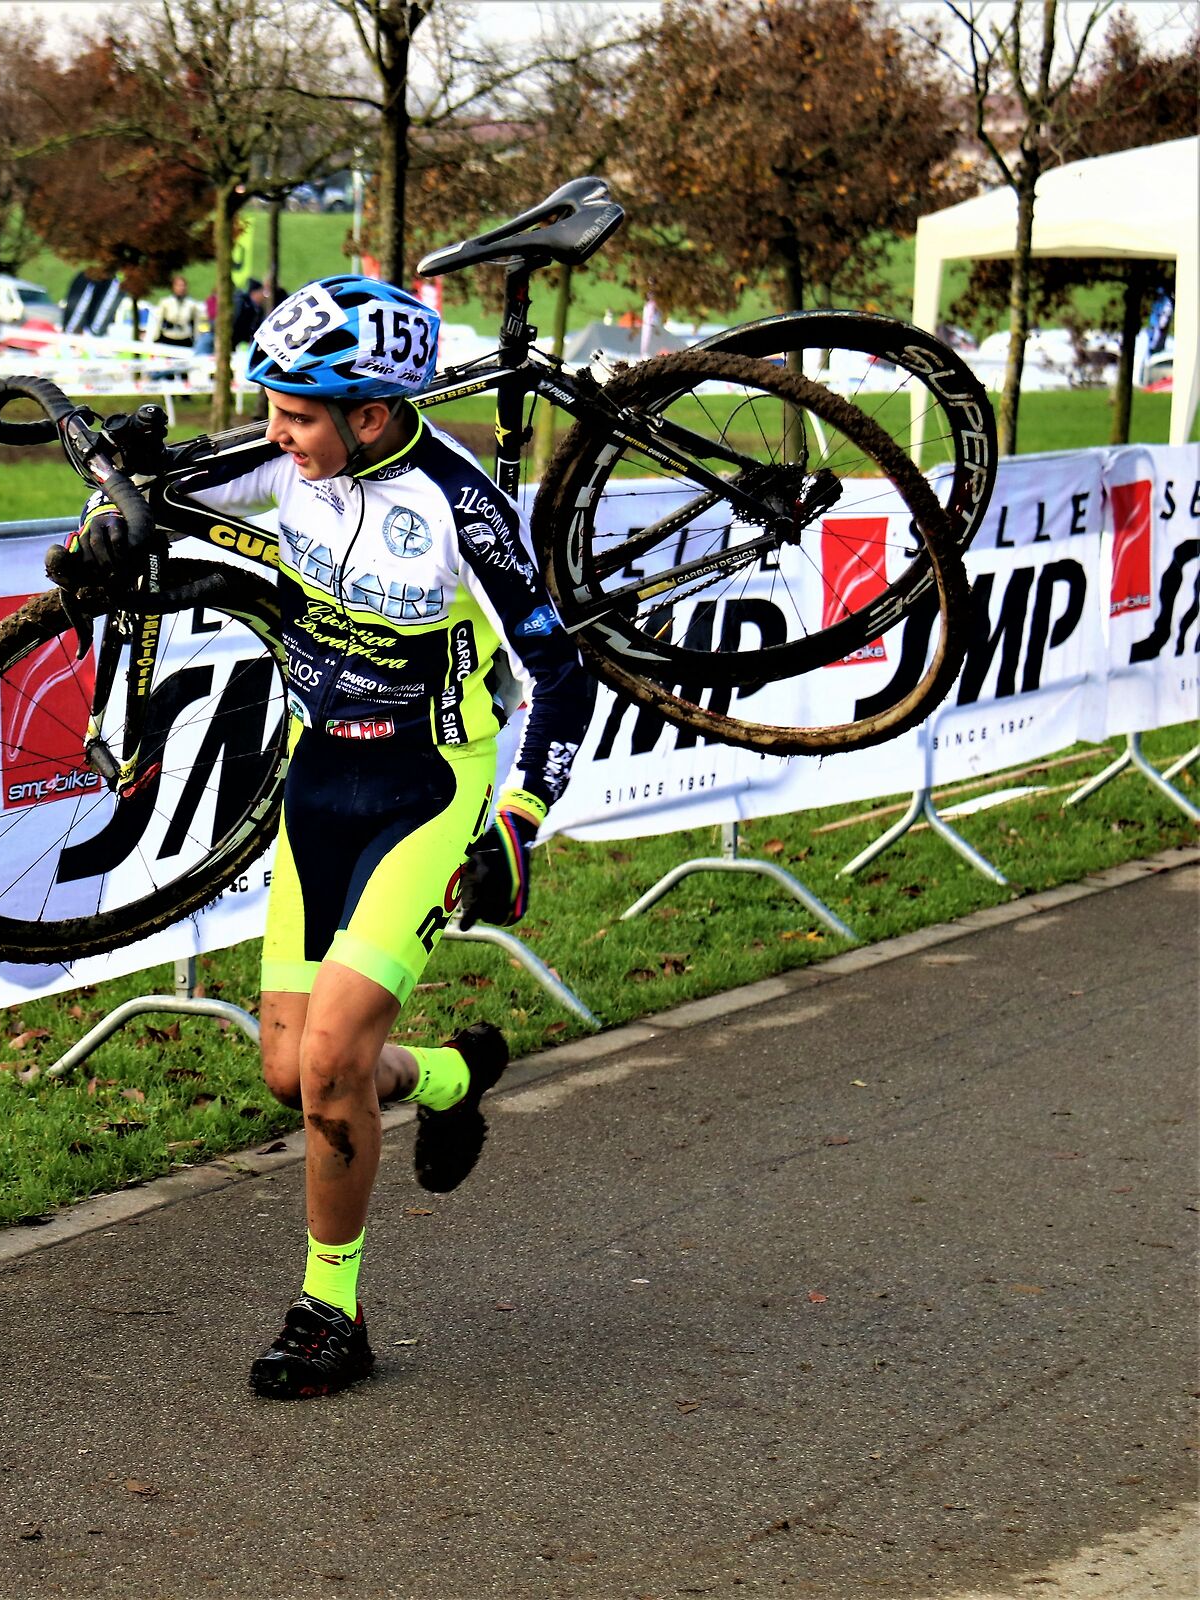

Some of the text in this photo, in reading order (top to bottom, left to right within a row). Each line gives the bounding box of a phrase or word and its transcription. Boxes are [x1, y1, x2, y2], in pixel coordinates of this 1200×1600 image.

[368, 308, 430, 369] 153
[548, 385, 576, 405] PUSH
[677, 548, 757, 583] CARBON DESIGN
[284, 651, 323, 687] LIOS
[340, 670, 378, 691] PARCO
[932, 716, 1035, 751] SINCE 1947
[604, 773, 717, 804] SINCE 1947
